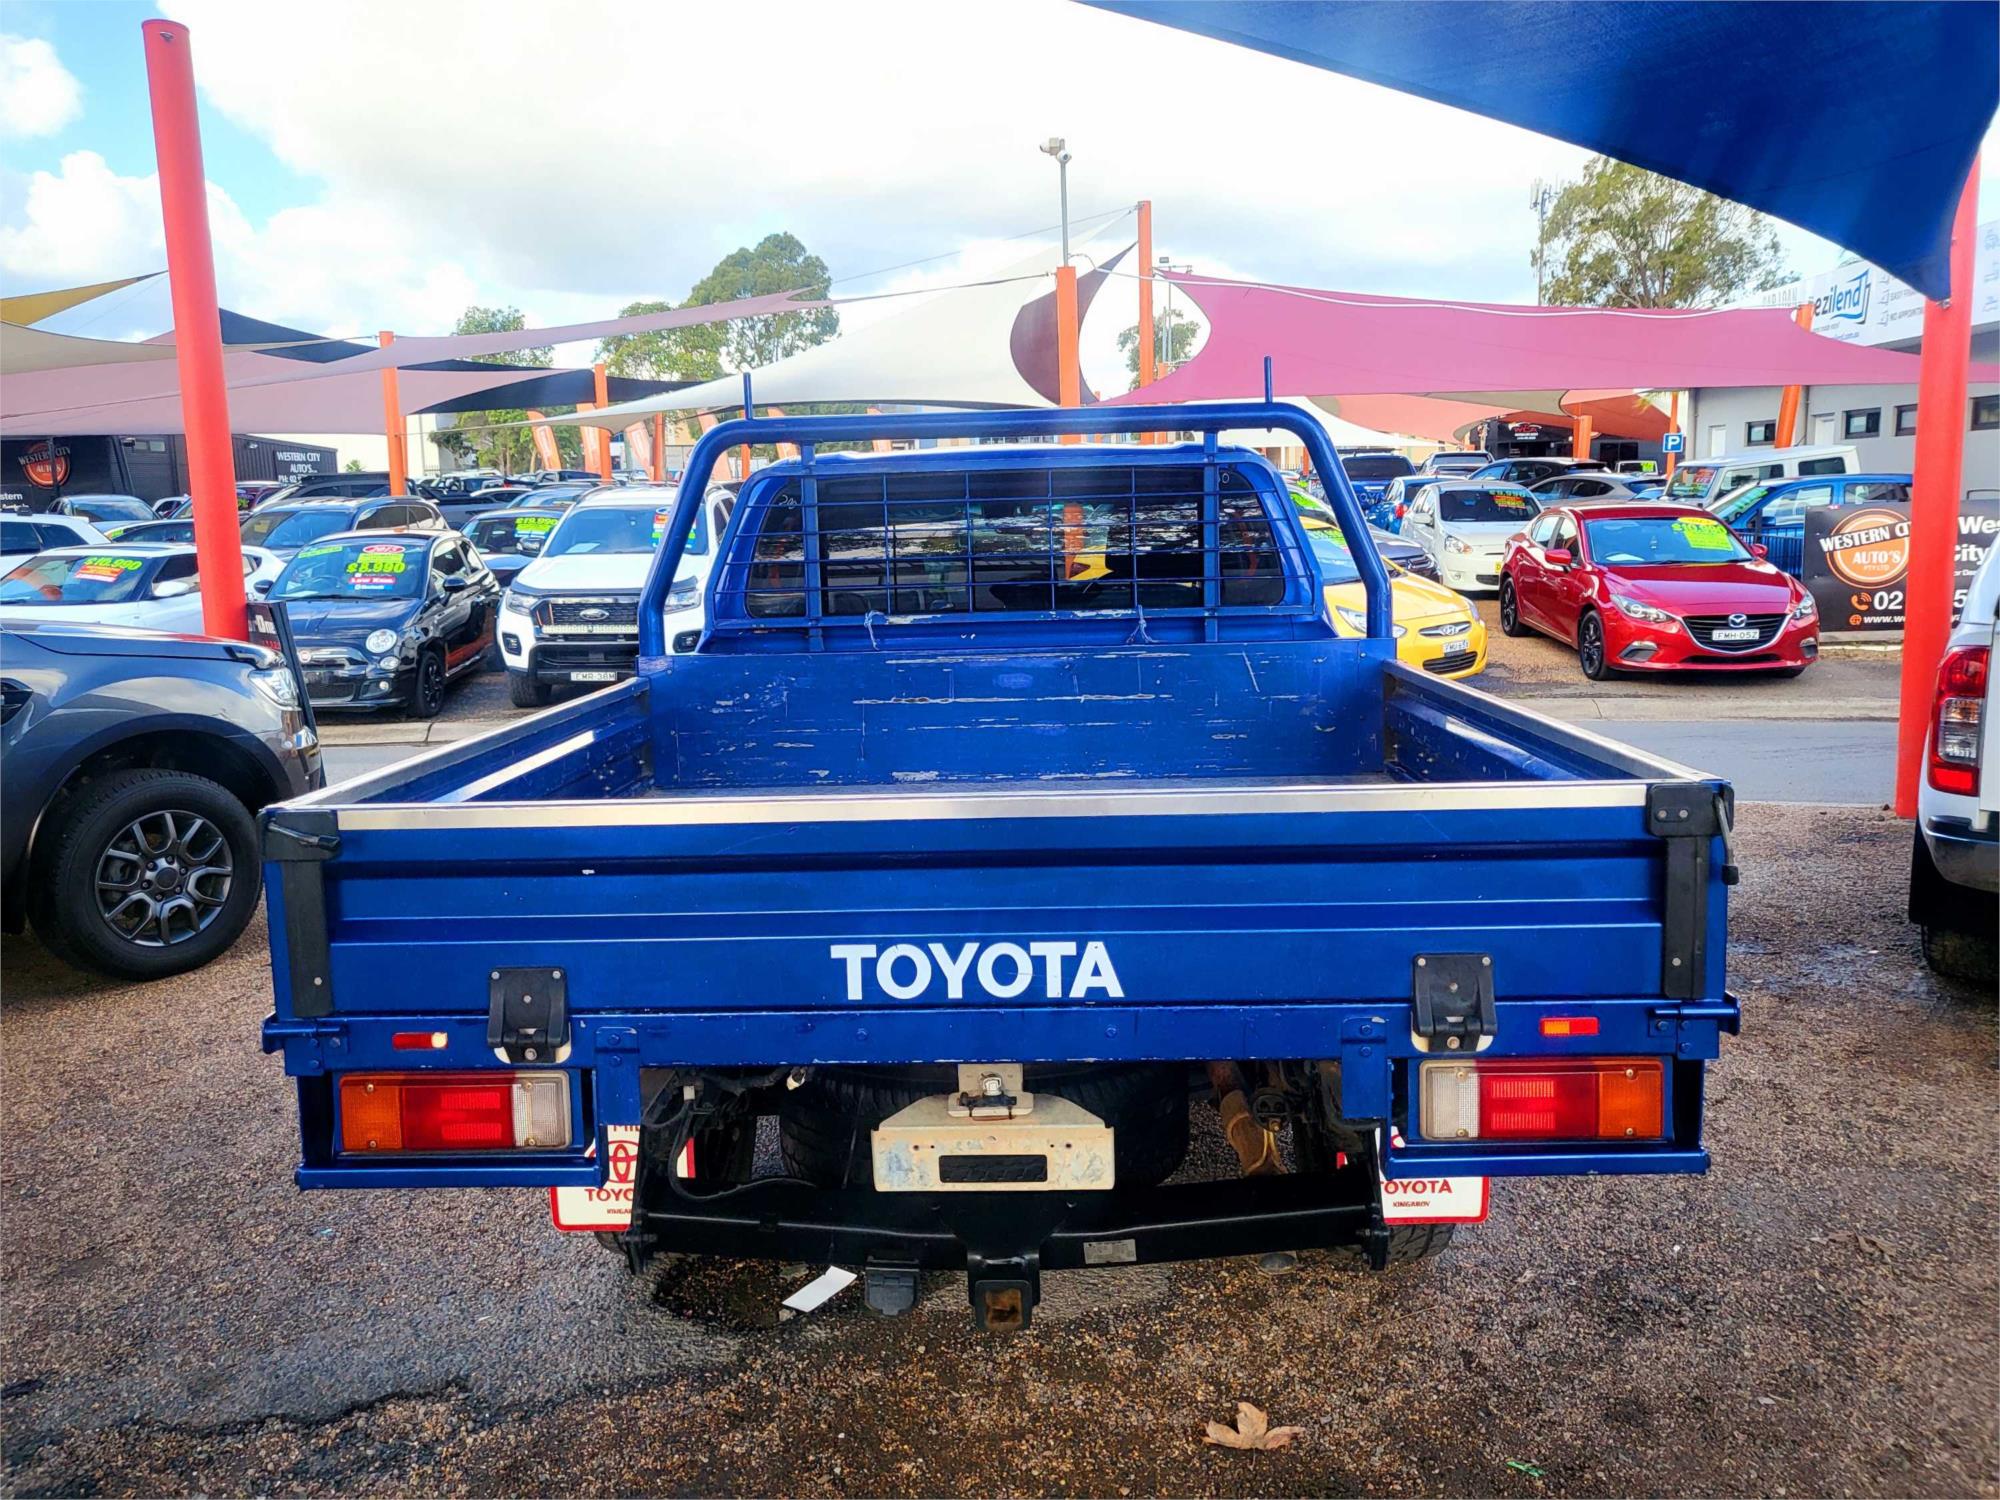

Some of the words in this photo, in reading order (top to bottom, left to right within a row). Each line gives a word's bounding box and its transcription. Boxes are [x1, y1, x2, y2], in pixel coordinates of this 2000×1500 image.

[1814, 280, 1863, 317] ezilend
[1667, 436, 1680, 450] P
[18, 451, 51, 466] WESTER
[276, 451, 307, 462] WESTERN
[307, 452, 321, 462] CITY
[1819, 526, 1891, 552] WESTERN
[1895, 522, 1912, 537] CI
[1853, 551, 1901, 565] AUTO'S
[1873, 591, 1903, 610] 02
[830, 941, 1125, 1001] TOYOTA
